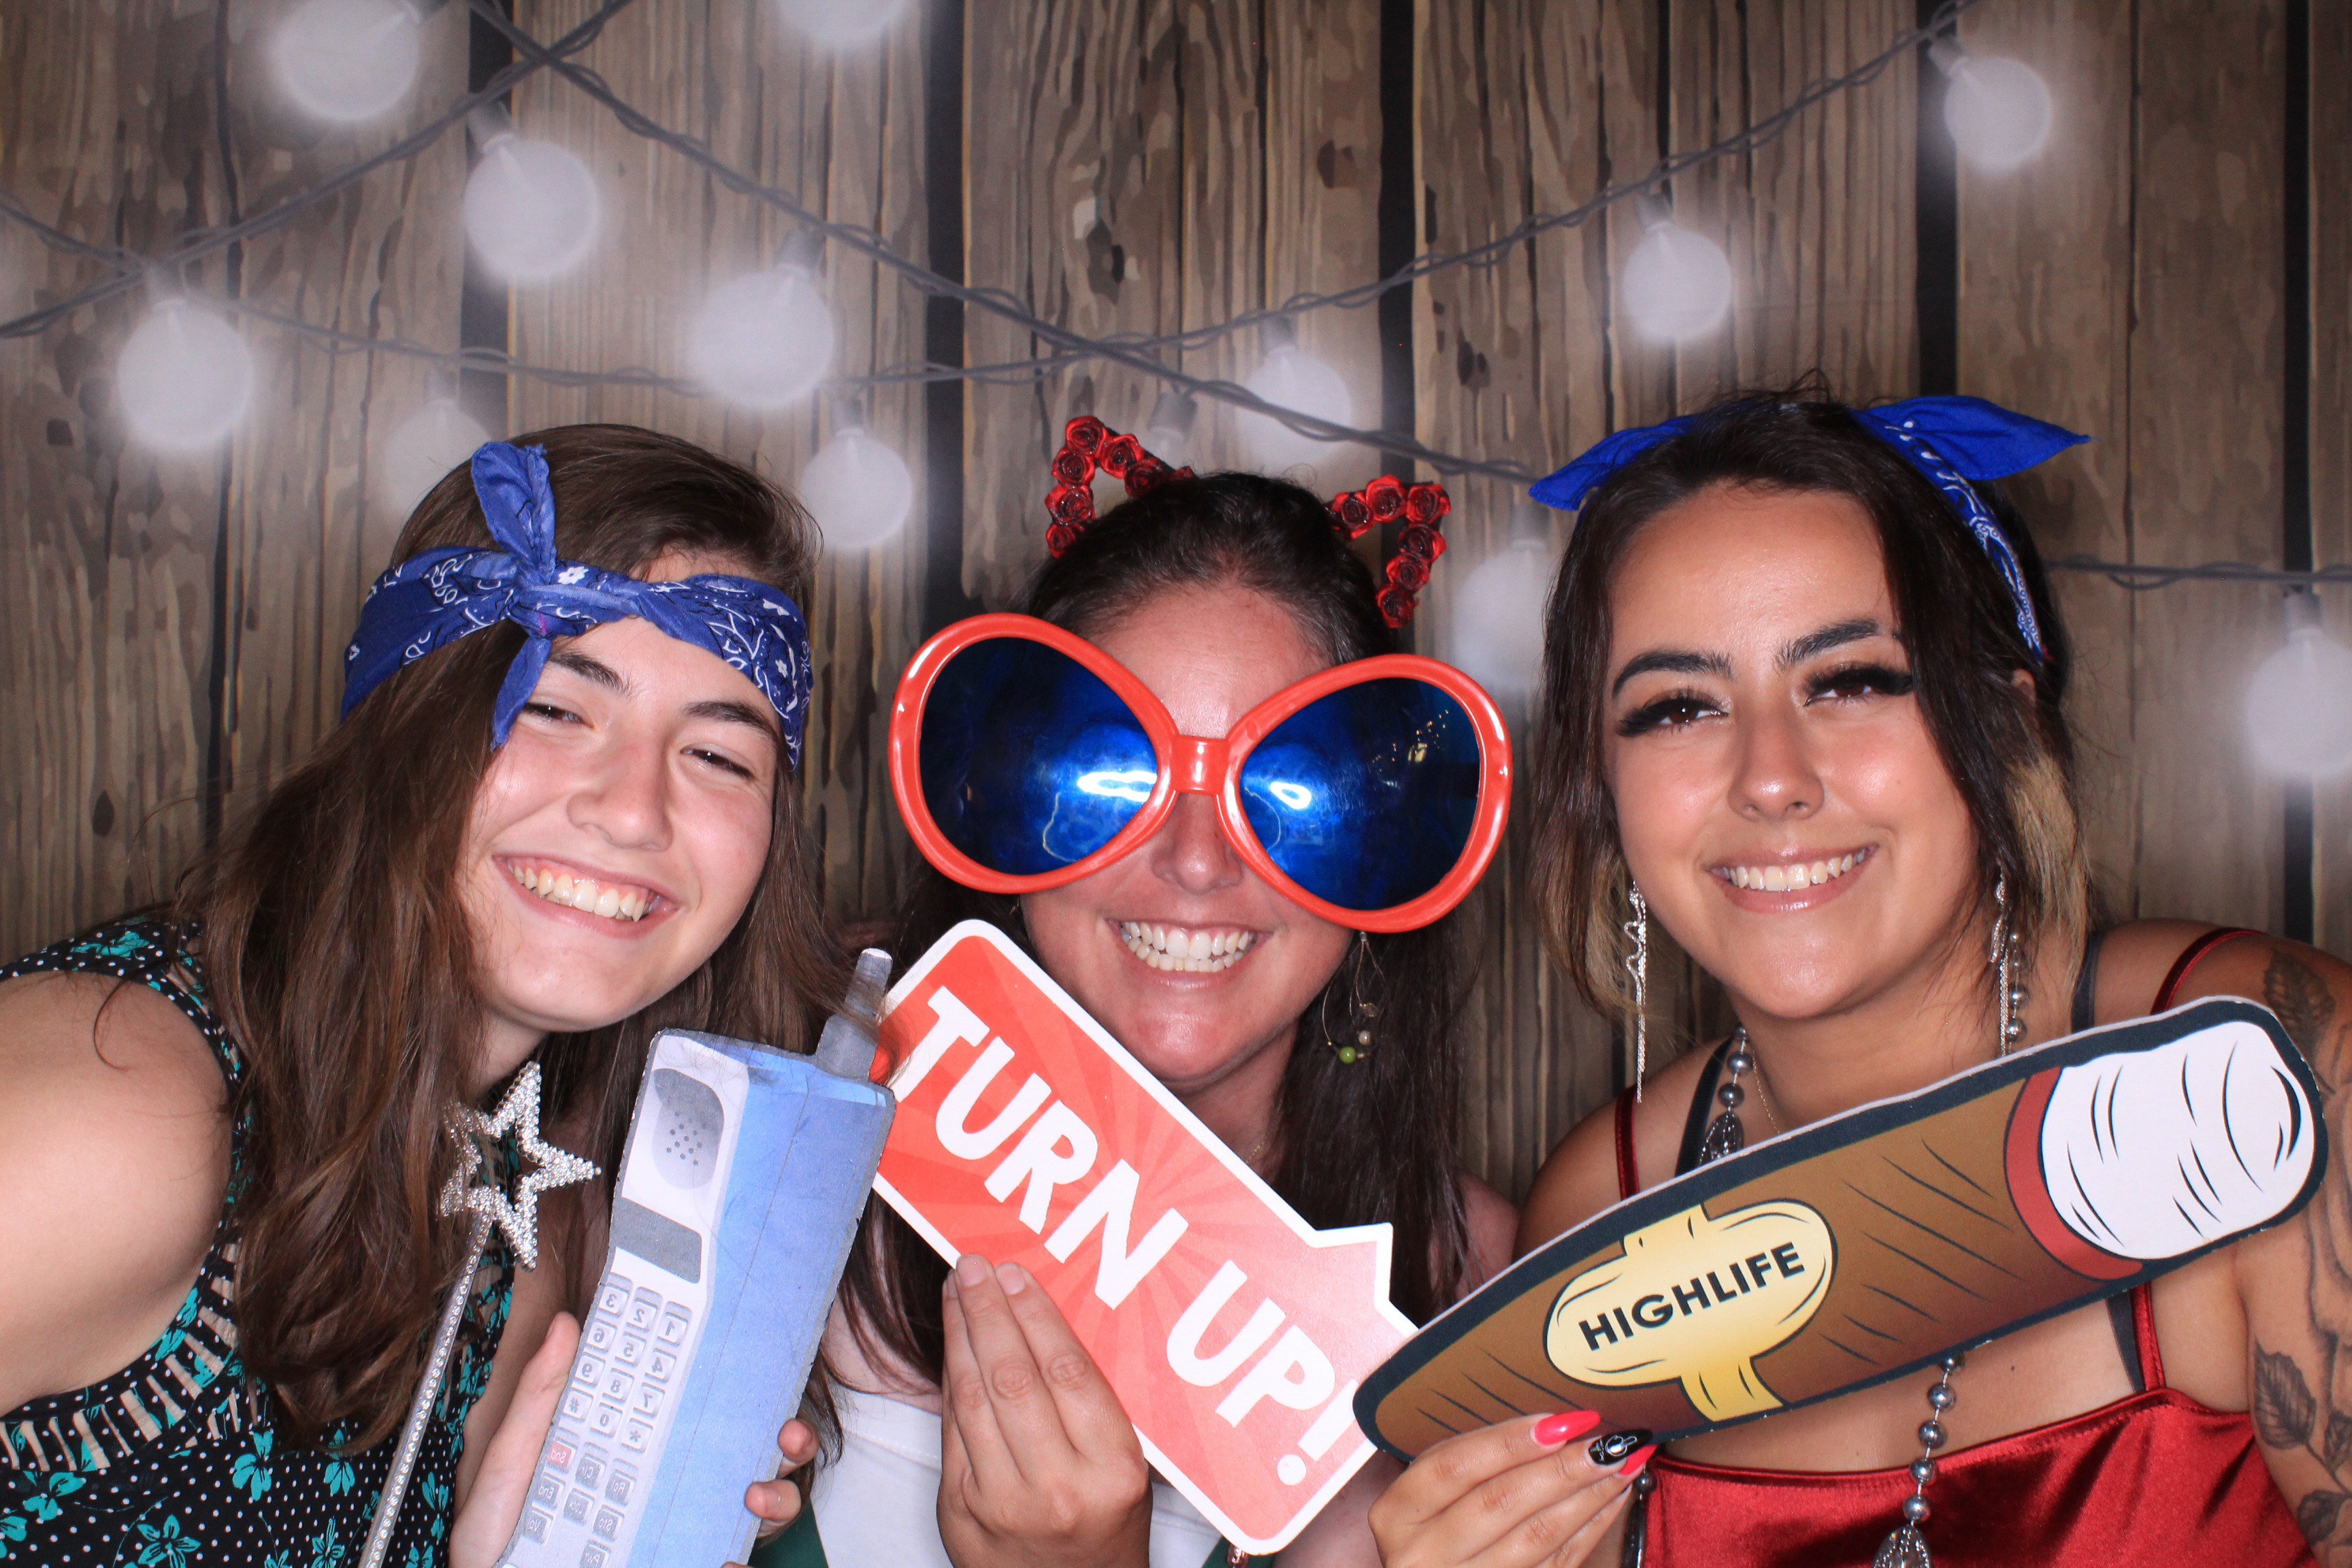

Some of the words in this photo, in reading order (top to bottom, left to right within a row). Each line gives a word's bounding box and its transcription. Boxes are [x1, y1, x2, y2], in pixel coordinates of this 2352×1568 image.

[887, 985, 1190, 1311] TURN
[1165, 1259, 1359, 1486] UP!
[1578, 1241, 1806, 1351] HIGHLIFE
